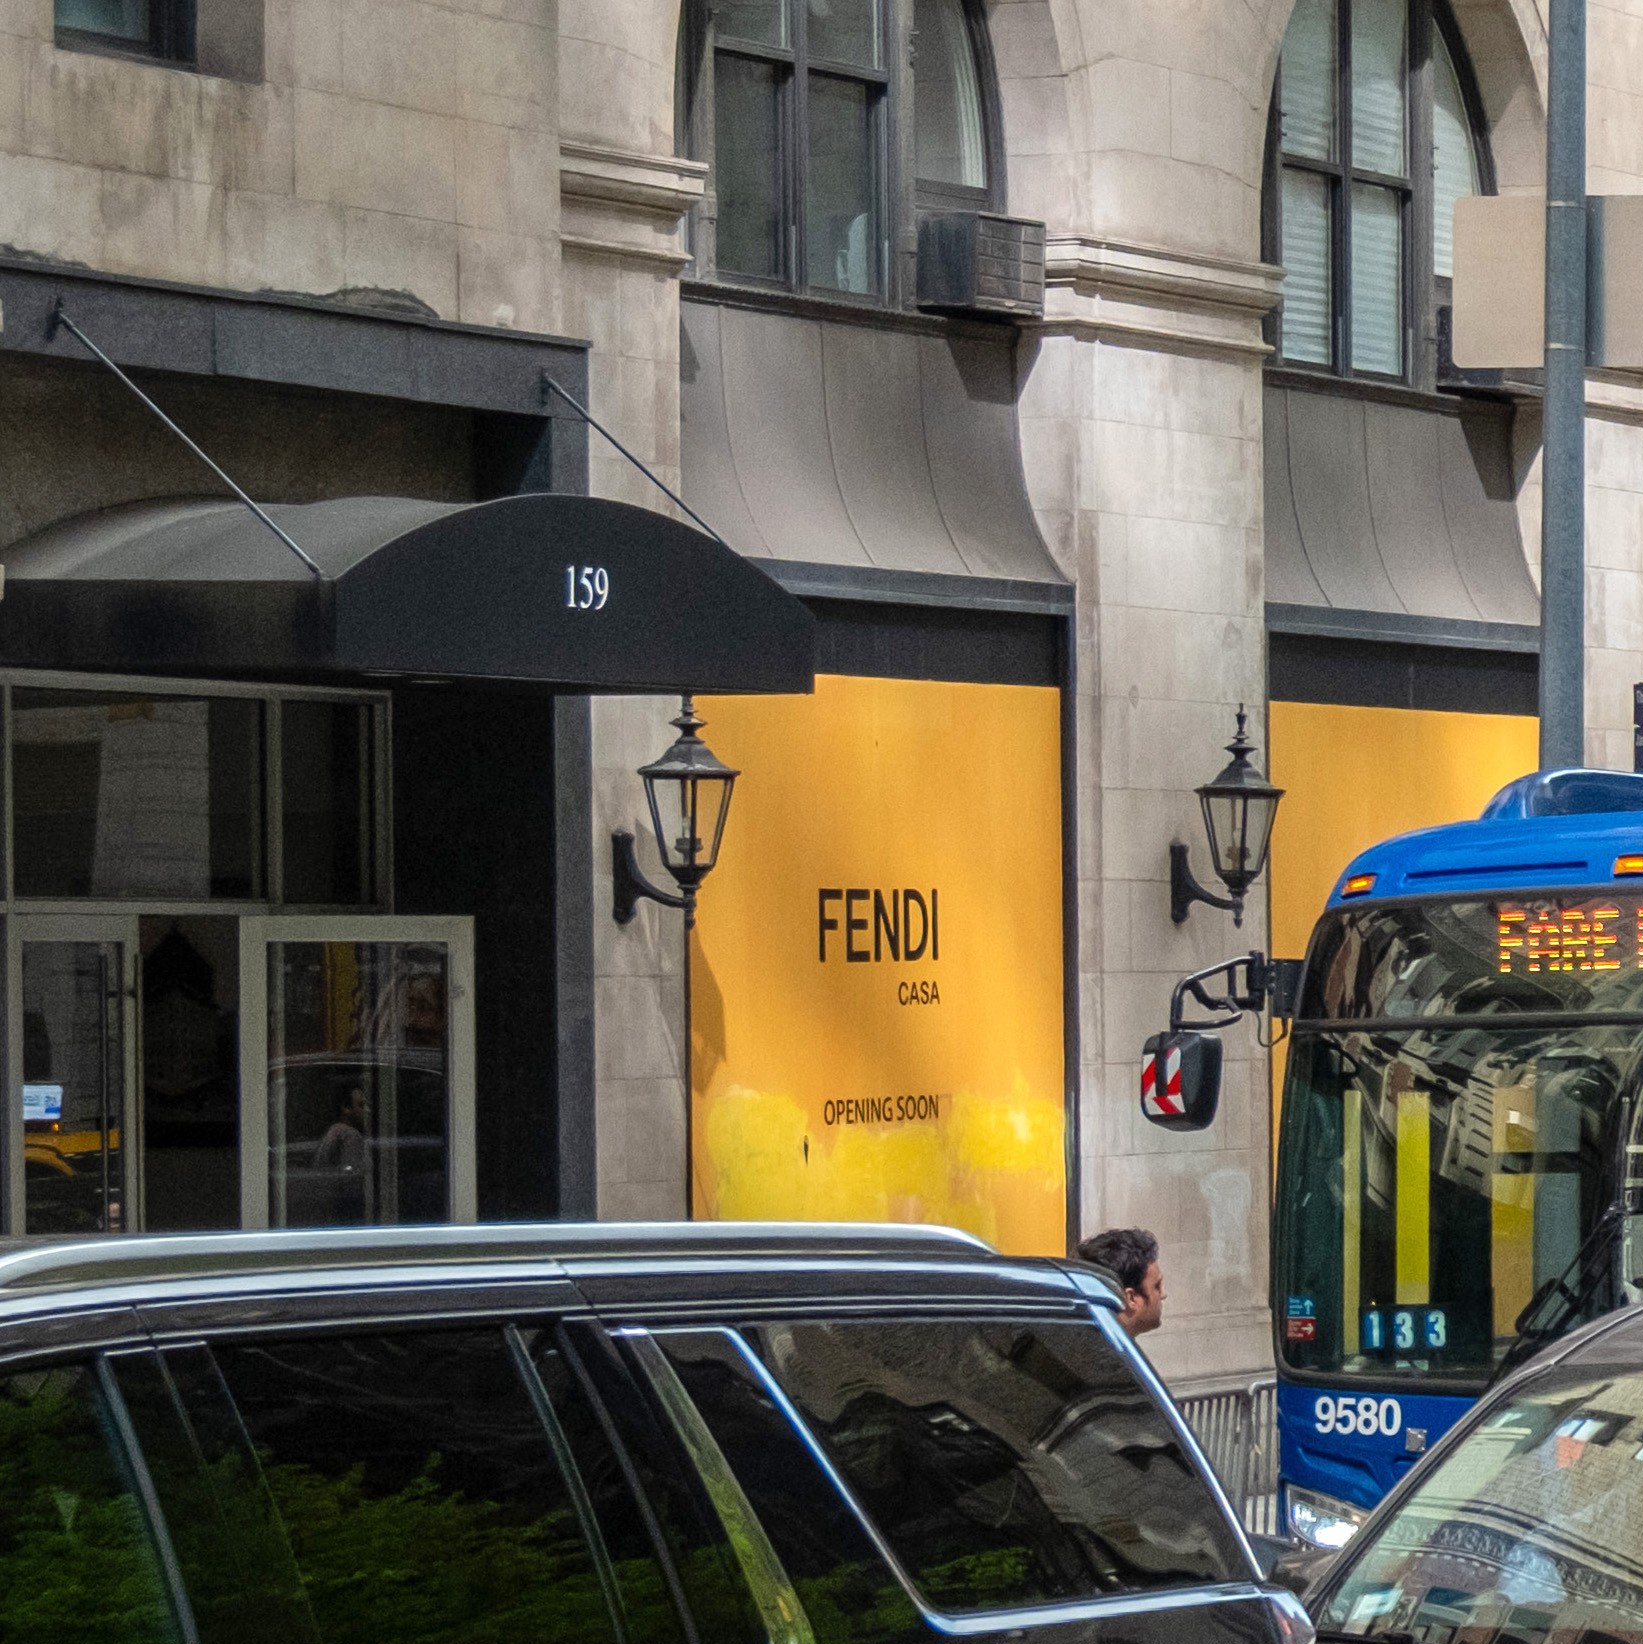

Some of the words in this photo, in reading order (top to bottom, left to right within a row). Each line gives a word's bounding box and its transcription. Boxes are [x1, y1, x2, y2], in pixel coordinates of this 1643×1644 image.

[567, 565, 610, 611] 159
[818, 888, 939, 963] FENDI
[1499, 908, 1622, 973] FARE
[897, 980, 941, 1006] CASA
[823, 1096, 893, 1126] OPENING
[896, 1093, 940, 1122] SOON
[1314, 1395, 1402, 1436] 9580
